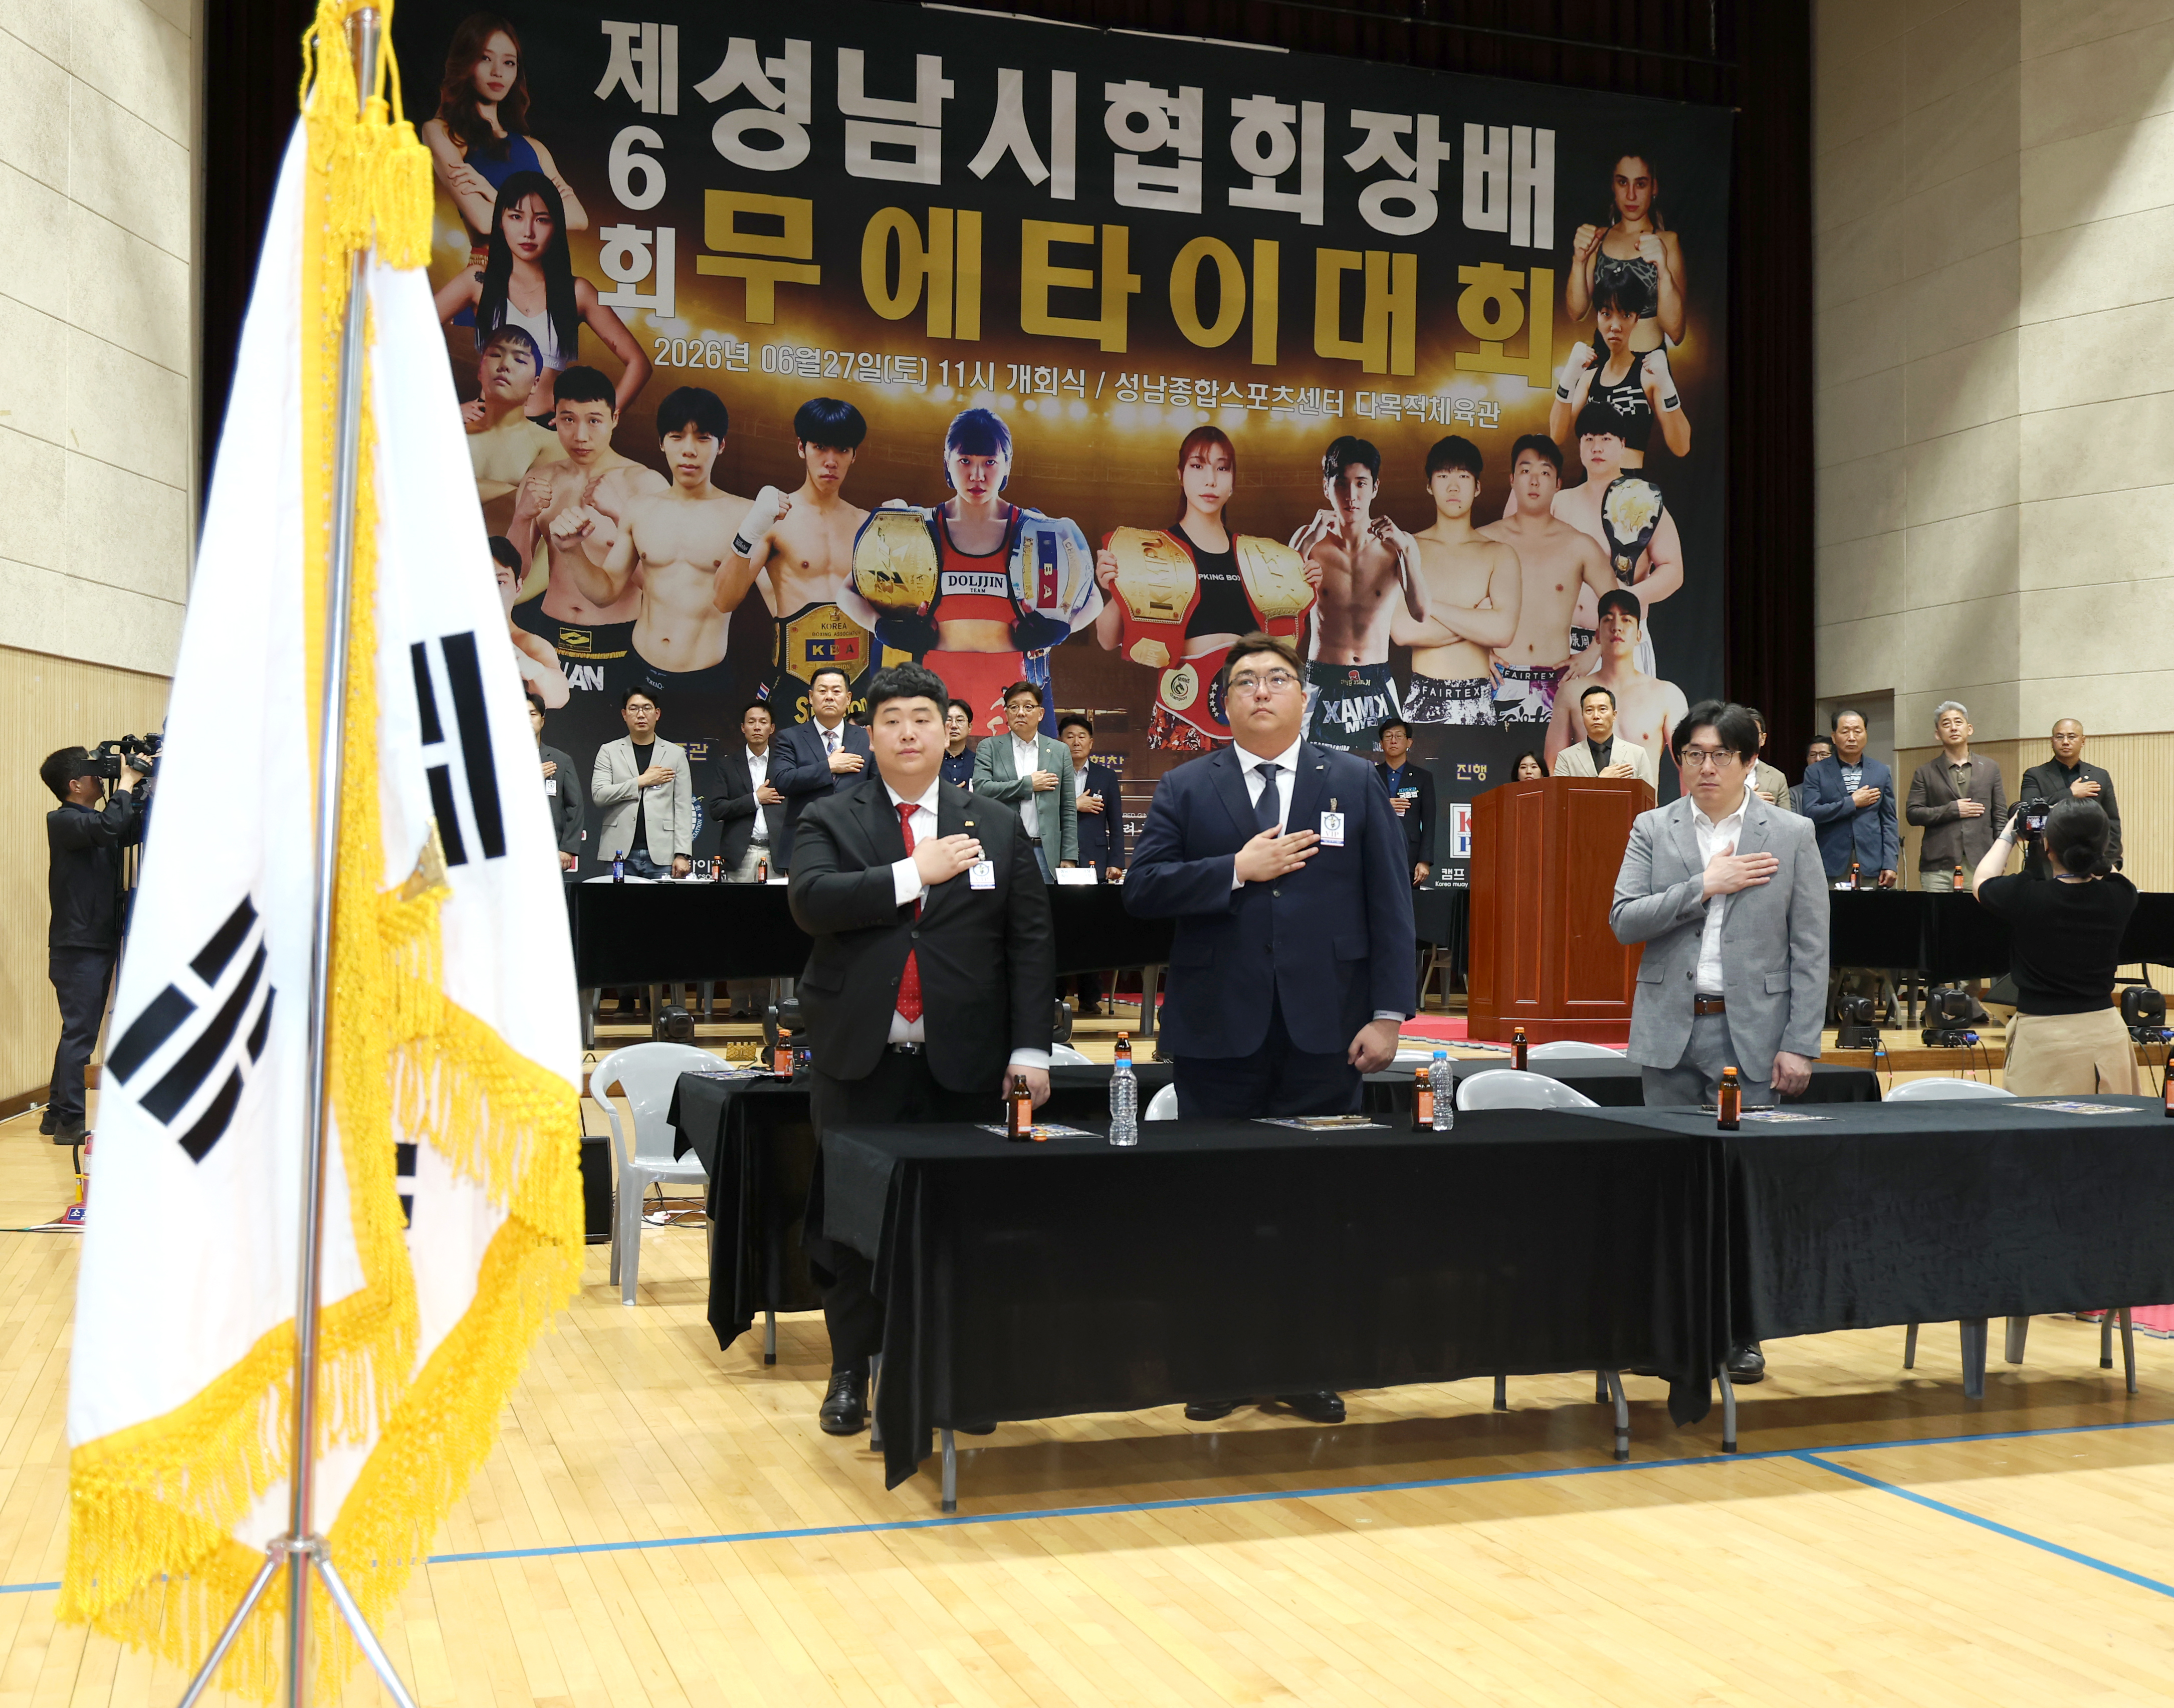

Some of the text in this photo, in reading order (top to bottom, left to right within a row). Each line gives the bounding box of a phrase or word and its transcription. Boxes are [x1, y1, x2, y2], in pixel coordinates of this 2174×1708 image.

[693, 37, 1555, 250] 성남시협회장배
[654, 338, 750, 373] 2026년
[938, 359, 995, 391] 11시
[1006, 364, 1086, 399] 개회식
[1114, 372, 1345, 418] 성남종합스포츠센터
[1355, 390, 1501, 429] 다목적체육관
[948, 575, 1003, 588] DOLJJIN
[1504, 671, 1555, 680] FAIRTEX
[1422, 686, 1480, 698] FAIRTEX
[1457, 764, 1487, 781] 진행
[1441, 868, 1464, 880] 캠프
